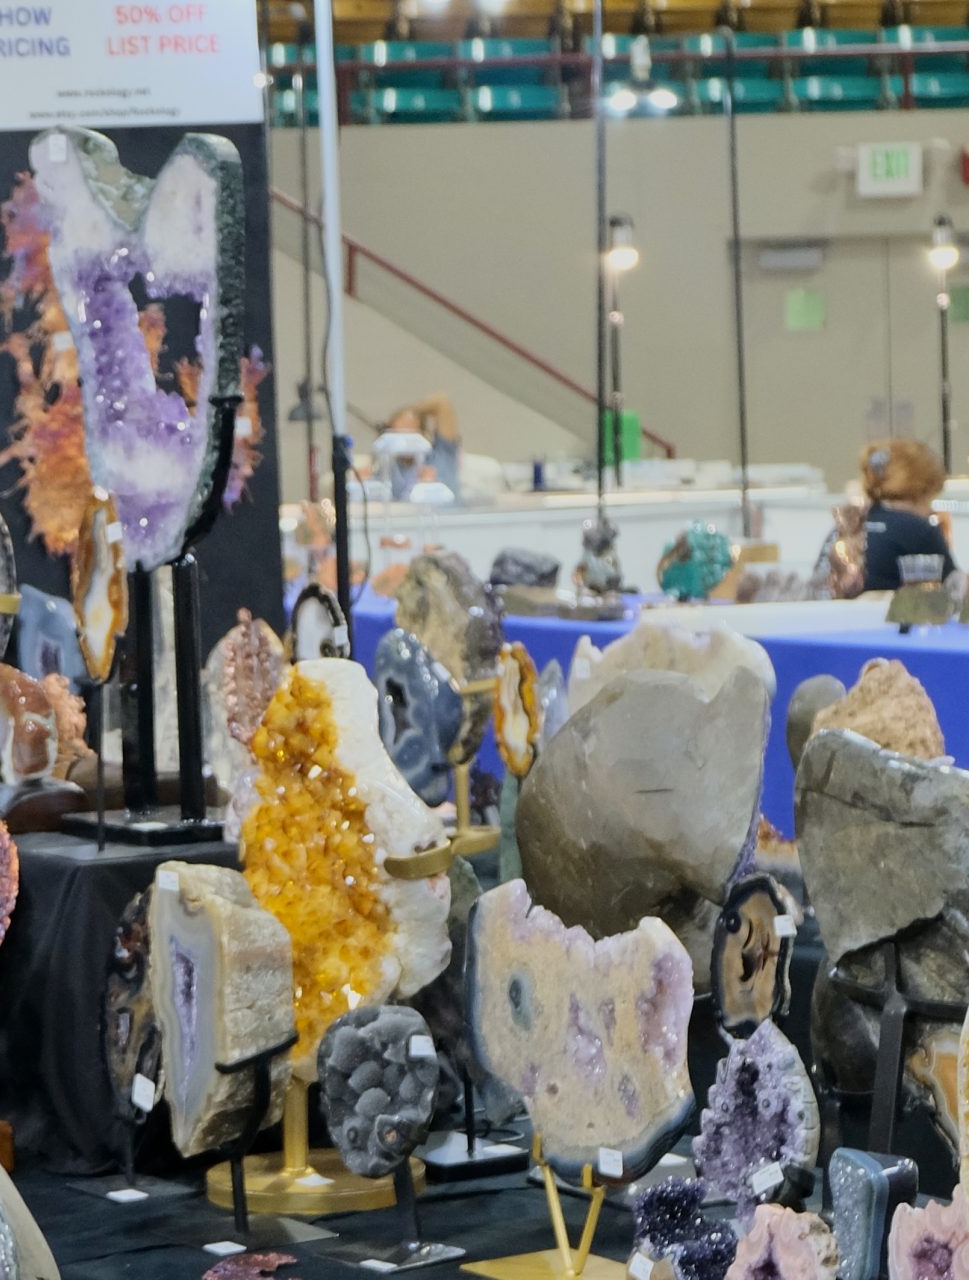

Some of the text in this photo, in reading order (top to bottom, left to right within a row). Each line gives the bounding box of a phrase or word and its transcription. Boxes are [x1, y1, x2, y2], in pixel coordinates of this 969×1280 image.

[115, 3, 208, 25] 50% OFF
[104, 34, 220, 57] LIST PRICE
